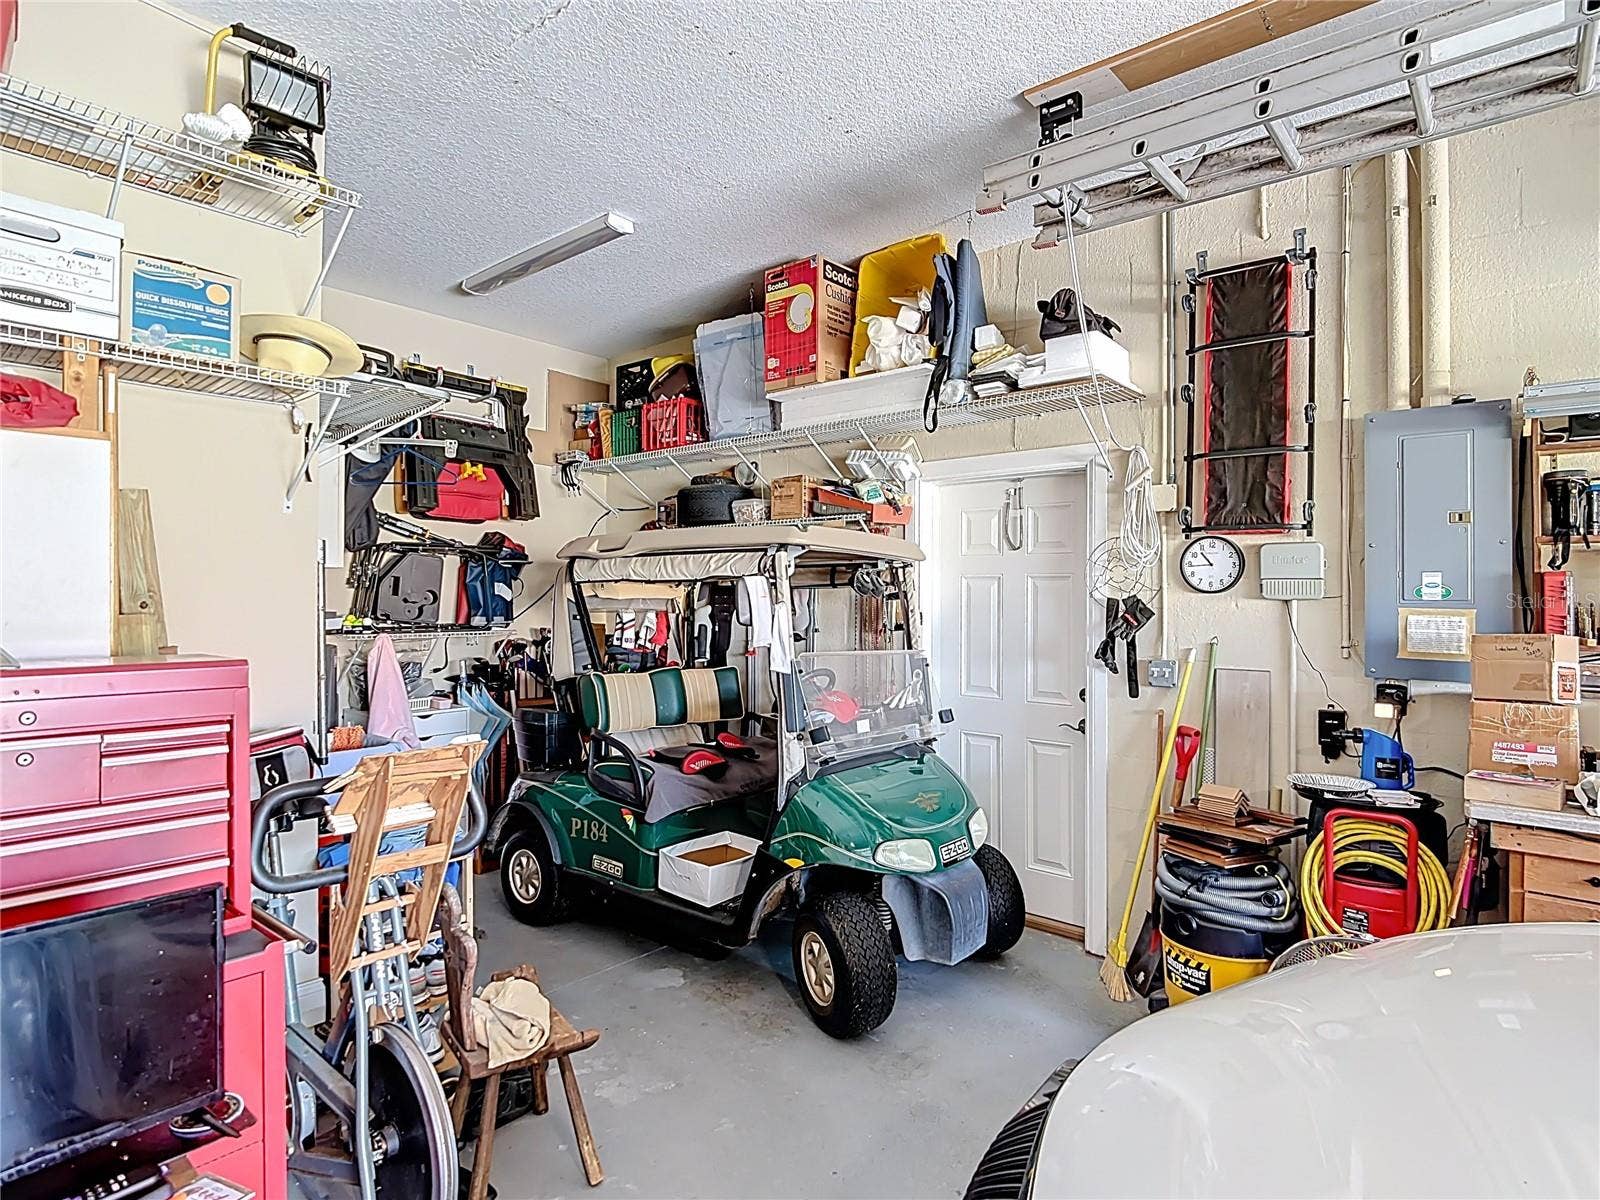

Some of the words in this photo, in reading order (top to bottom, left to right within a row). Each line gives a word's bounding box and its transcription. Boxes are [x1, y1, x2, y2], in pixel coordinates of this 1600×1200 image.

[137, 259, 197, 278] PoolBrand
[767, 280, 789, 292] Scotch
[825, 283, 855, 305] Cushio
[43, 298, 68, 310] BOX
[135, 291, 160, 303] QUICK
[160, 296, 205, 312] DISSOLVING
[204, 305, 230, 317] SHOCK
[1208, 541, 1217, 549] 12
[1191, 551, 1199, 559] 10
[1208, 580, 1214, 588] 6
[570, 817, 608, 843] P184
[1171, 972, 1183, 988] 12
